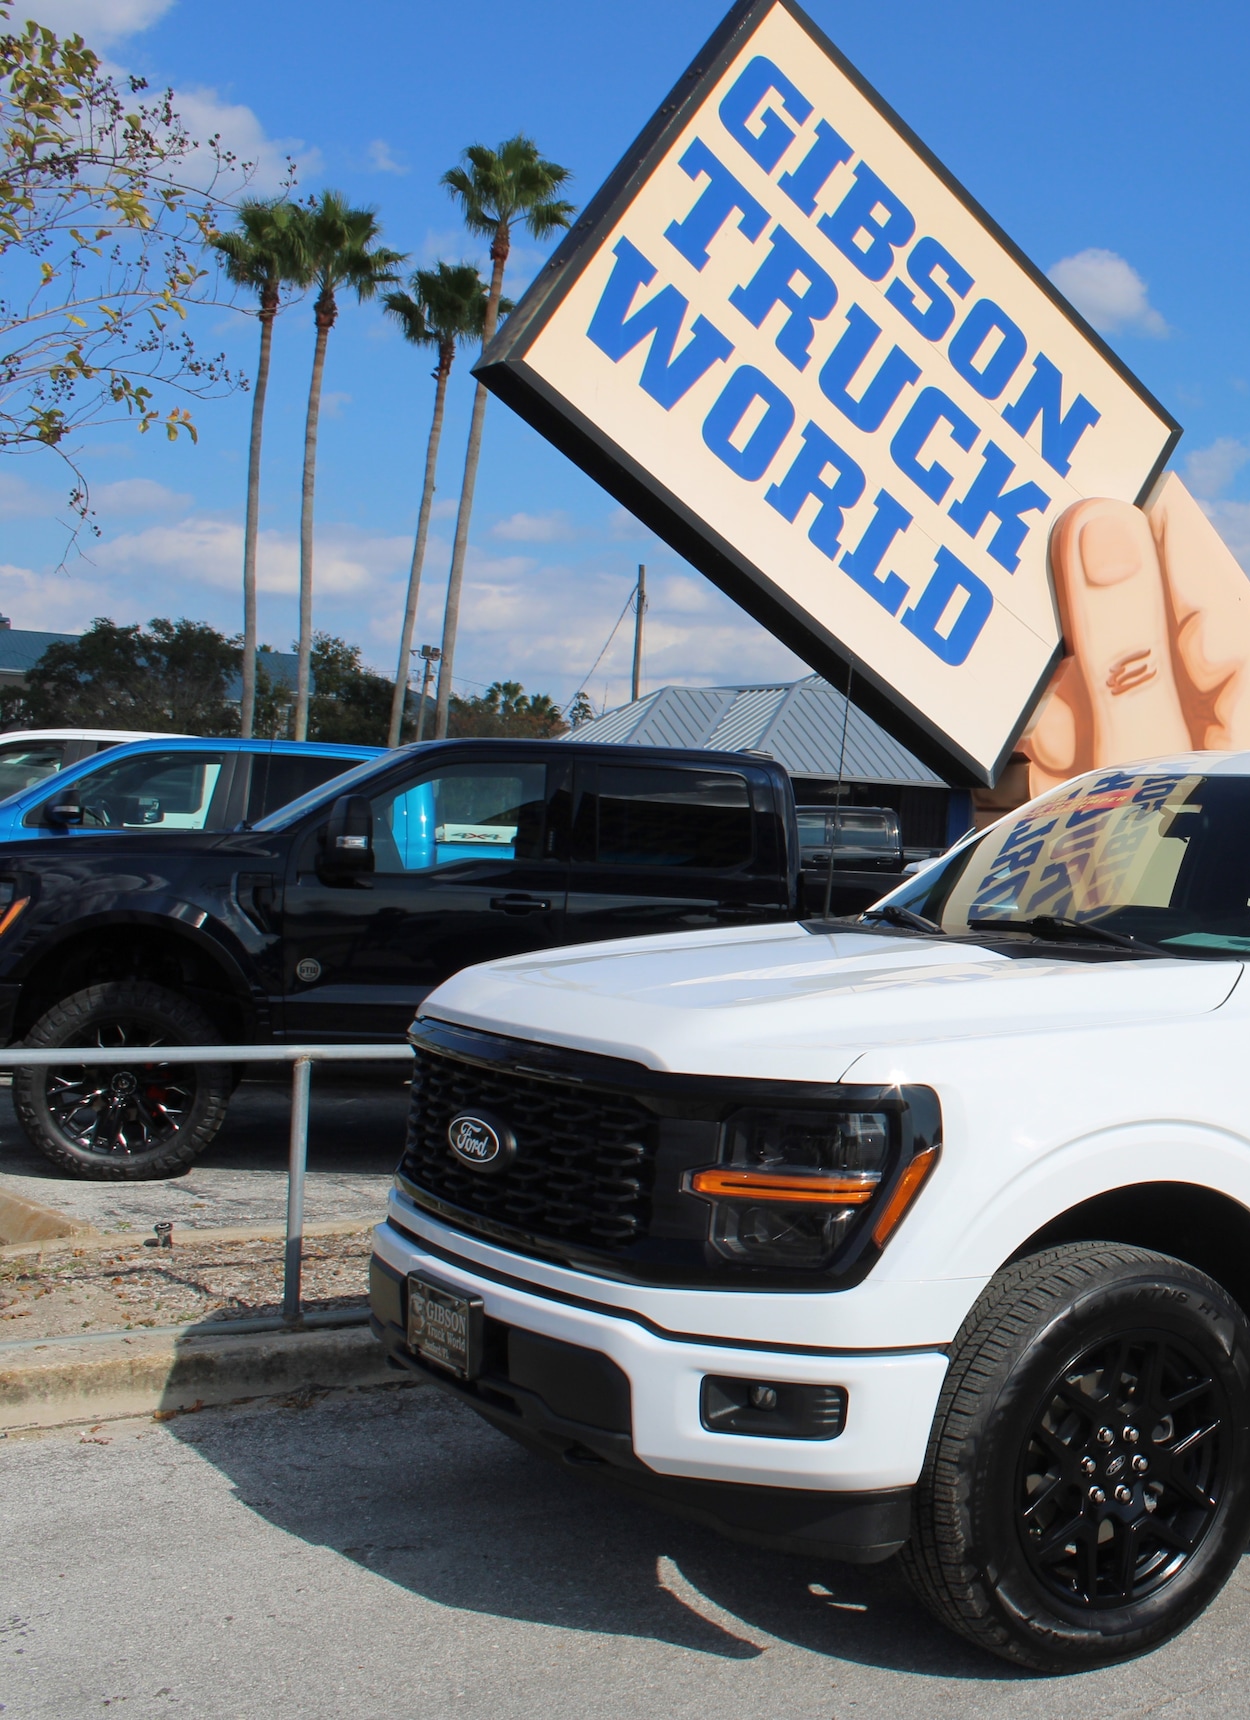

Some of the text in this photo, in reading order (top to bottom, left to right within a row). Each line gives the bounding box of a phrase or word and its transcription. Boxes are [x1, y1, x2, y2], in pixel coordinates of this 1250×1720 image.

[664, 138, 1049, 573] TRUCK
[719, 56, 1100, 477] GIBSON
[586, 237, 992, 666] WORLD
[457, 1121, 489, 1157] Ford
[426, 1300, 466, 1336] GIBSON
[426, 1322, 466, 1353] Truck World
